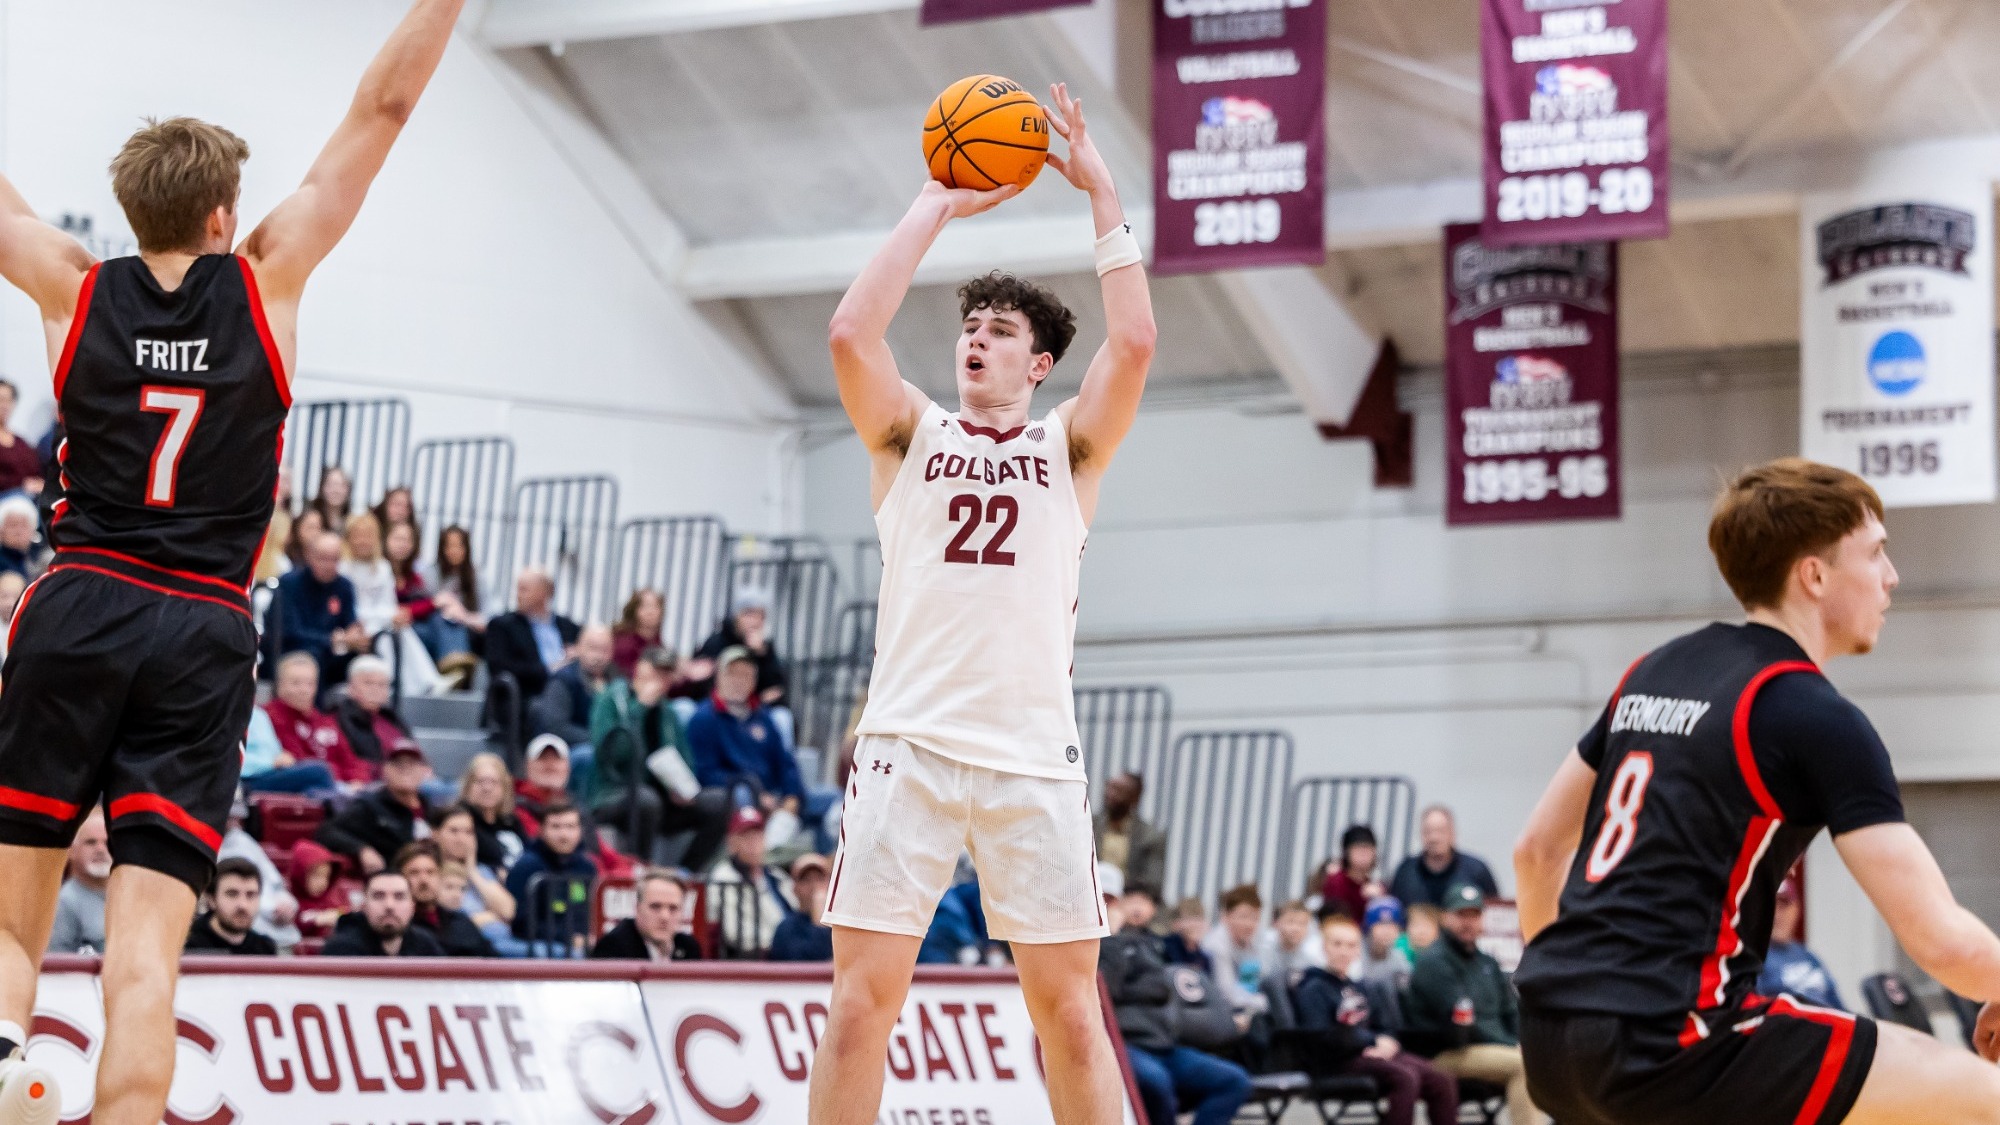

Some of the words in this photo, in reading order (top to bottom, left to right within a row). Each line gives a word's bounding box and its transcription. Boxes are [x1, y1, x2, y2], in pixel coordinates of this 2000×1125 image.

[1498, 166, 1654, 222] 2019-20
[1194, 198, 1281, 246] 2019
[136, 339, 209, 372] FRITZ
[139, 384, 206, 509] 7
[925, 452, 1049, 489] COLGATE
[1860, 441, 1941, 476] 1996
[1463, 455, 1608, 503] 1995-96
[944, 494, 1019, 566] 22
[1585, 751, 1654, 883] 8
[244, 1003, 546, 1093] COLGATE
